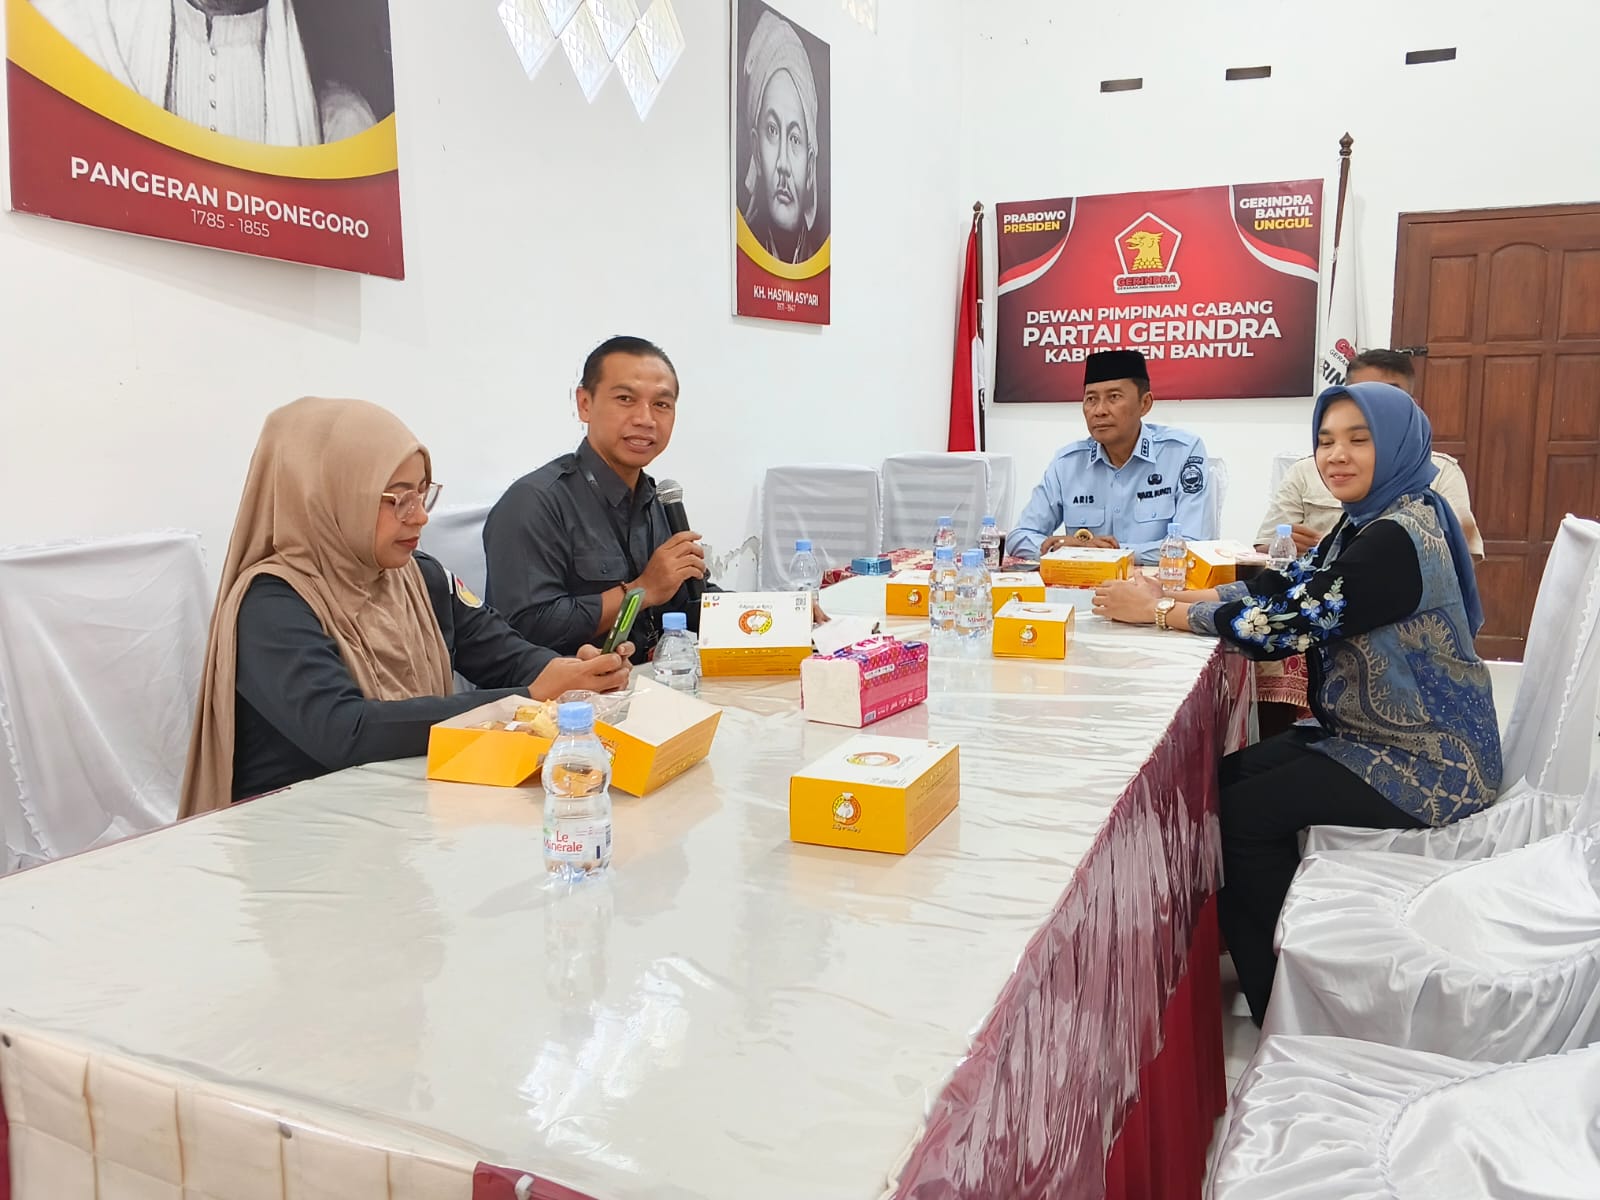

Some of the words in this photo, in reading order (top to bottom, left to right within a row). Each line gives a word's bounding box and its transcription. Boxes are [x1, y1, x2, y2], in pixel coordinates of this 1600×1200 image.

[70, 156, 219, 208] PANGERAN
[226, 190, 370, 239] DIPONEGORO
[1239, 194, 1314, 209] GERINDRA
[1003, 210, 1066, 223] PRABOWO
[1255, 206, 1313, 219] BANTUL
[190, 208, 226, 230] 1785
[238, 218, 271, 238] 1855
[1003, 221, 1061, 234] PRESIDEN
[1254, 217, 1313, 231] UNGGUL
[1117, 275, 1177, 287] GERINDRA
[753, 284, 767, 299] KH.
[767, 287, 794, 303] HASYIM
[794, 292, 819, 306] ASY'ARI
[1026, 307, 1093, 324] DEWAN
[1097, 303, 1187, 321] PIMPINAN
[1191, 300, 1273, 317] CABANG
[1022, 323, 1121, 347] PARTAI
[1128, 317, 1282, 343] GERINDRA
[1045, 344, 1165, 363] KABEN
[1170, 342, 1254, 360] BANTUL
[1072, 495, 1095, 504] ARIS
[556, 830, 569, 843] Le
